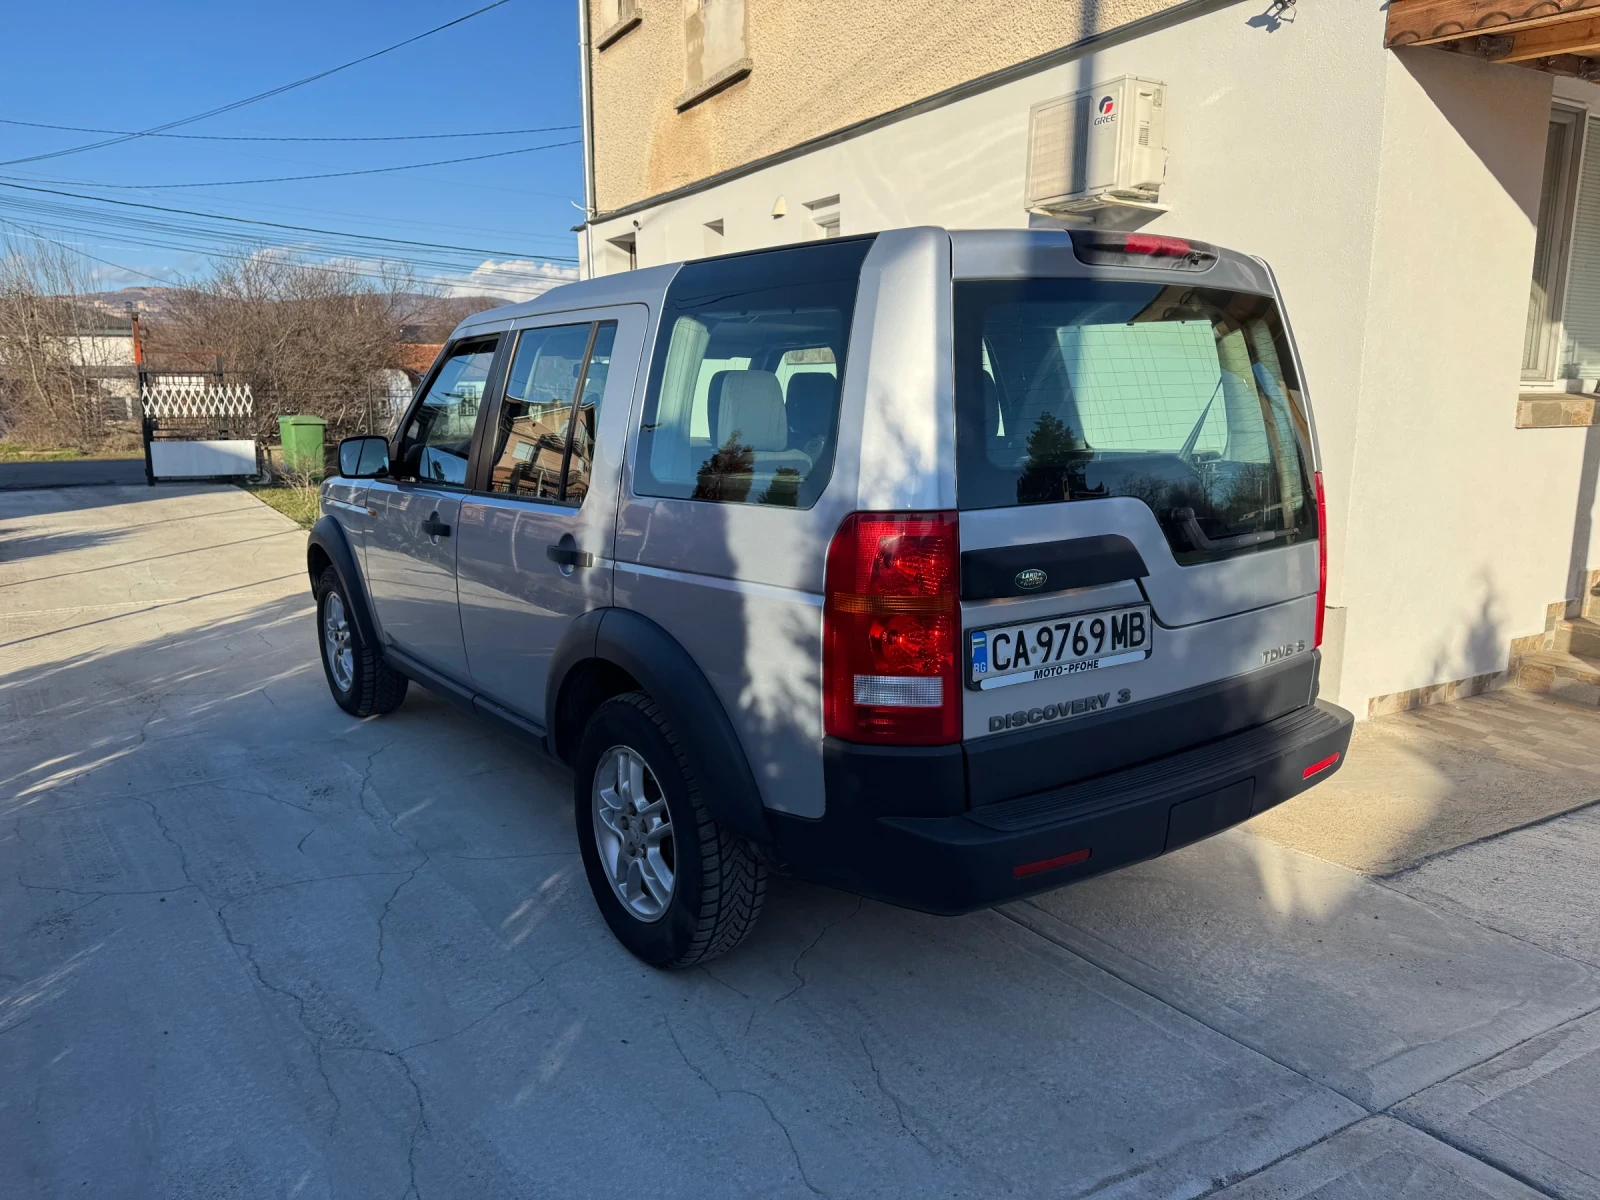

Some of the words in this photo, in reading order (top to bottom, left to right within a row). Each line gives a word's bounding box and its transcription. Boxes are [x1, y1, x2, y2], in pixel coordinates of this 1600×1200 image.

[1094, 114, 1116, 126] GREE
[1023, 577, 1043, 586] ROVER
[992, 630, 1030, 671] CA
[1036, 618, 1106, 663] 9769
[1111, 611, 1146, 650] MB
[973, 662, 987, 673] BG
[1033, 660, 1099, 680] MOTO-PFOHE
[989, 692, 1111, 732] DISCOVERY
[1117, 688, 1132, 704] 3
